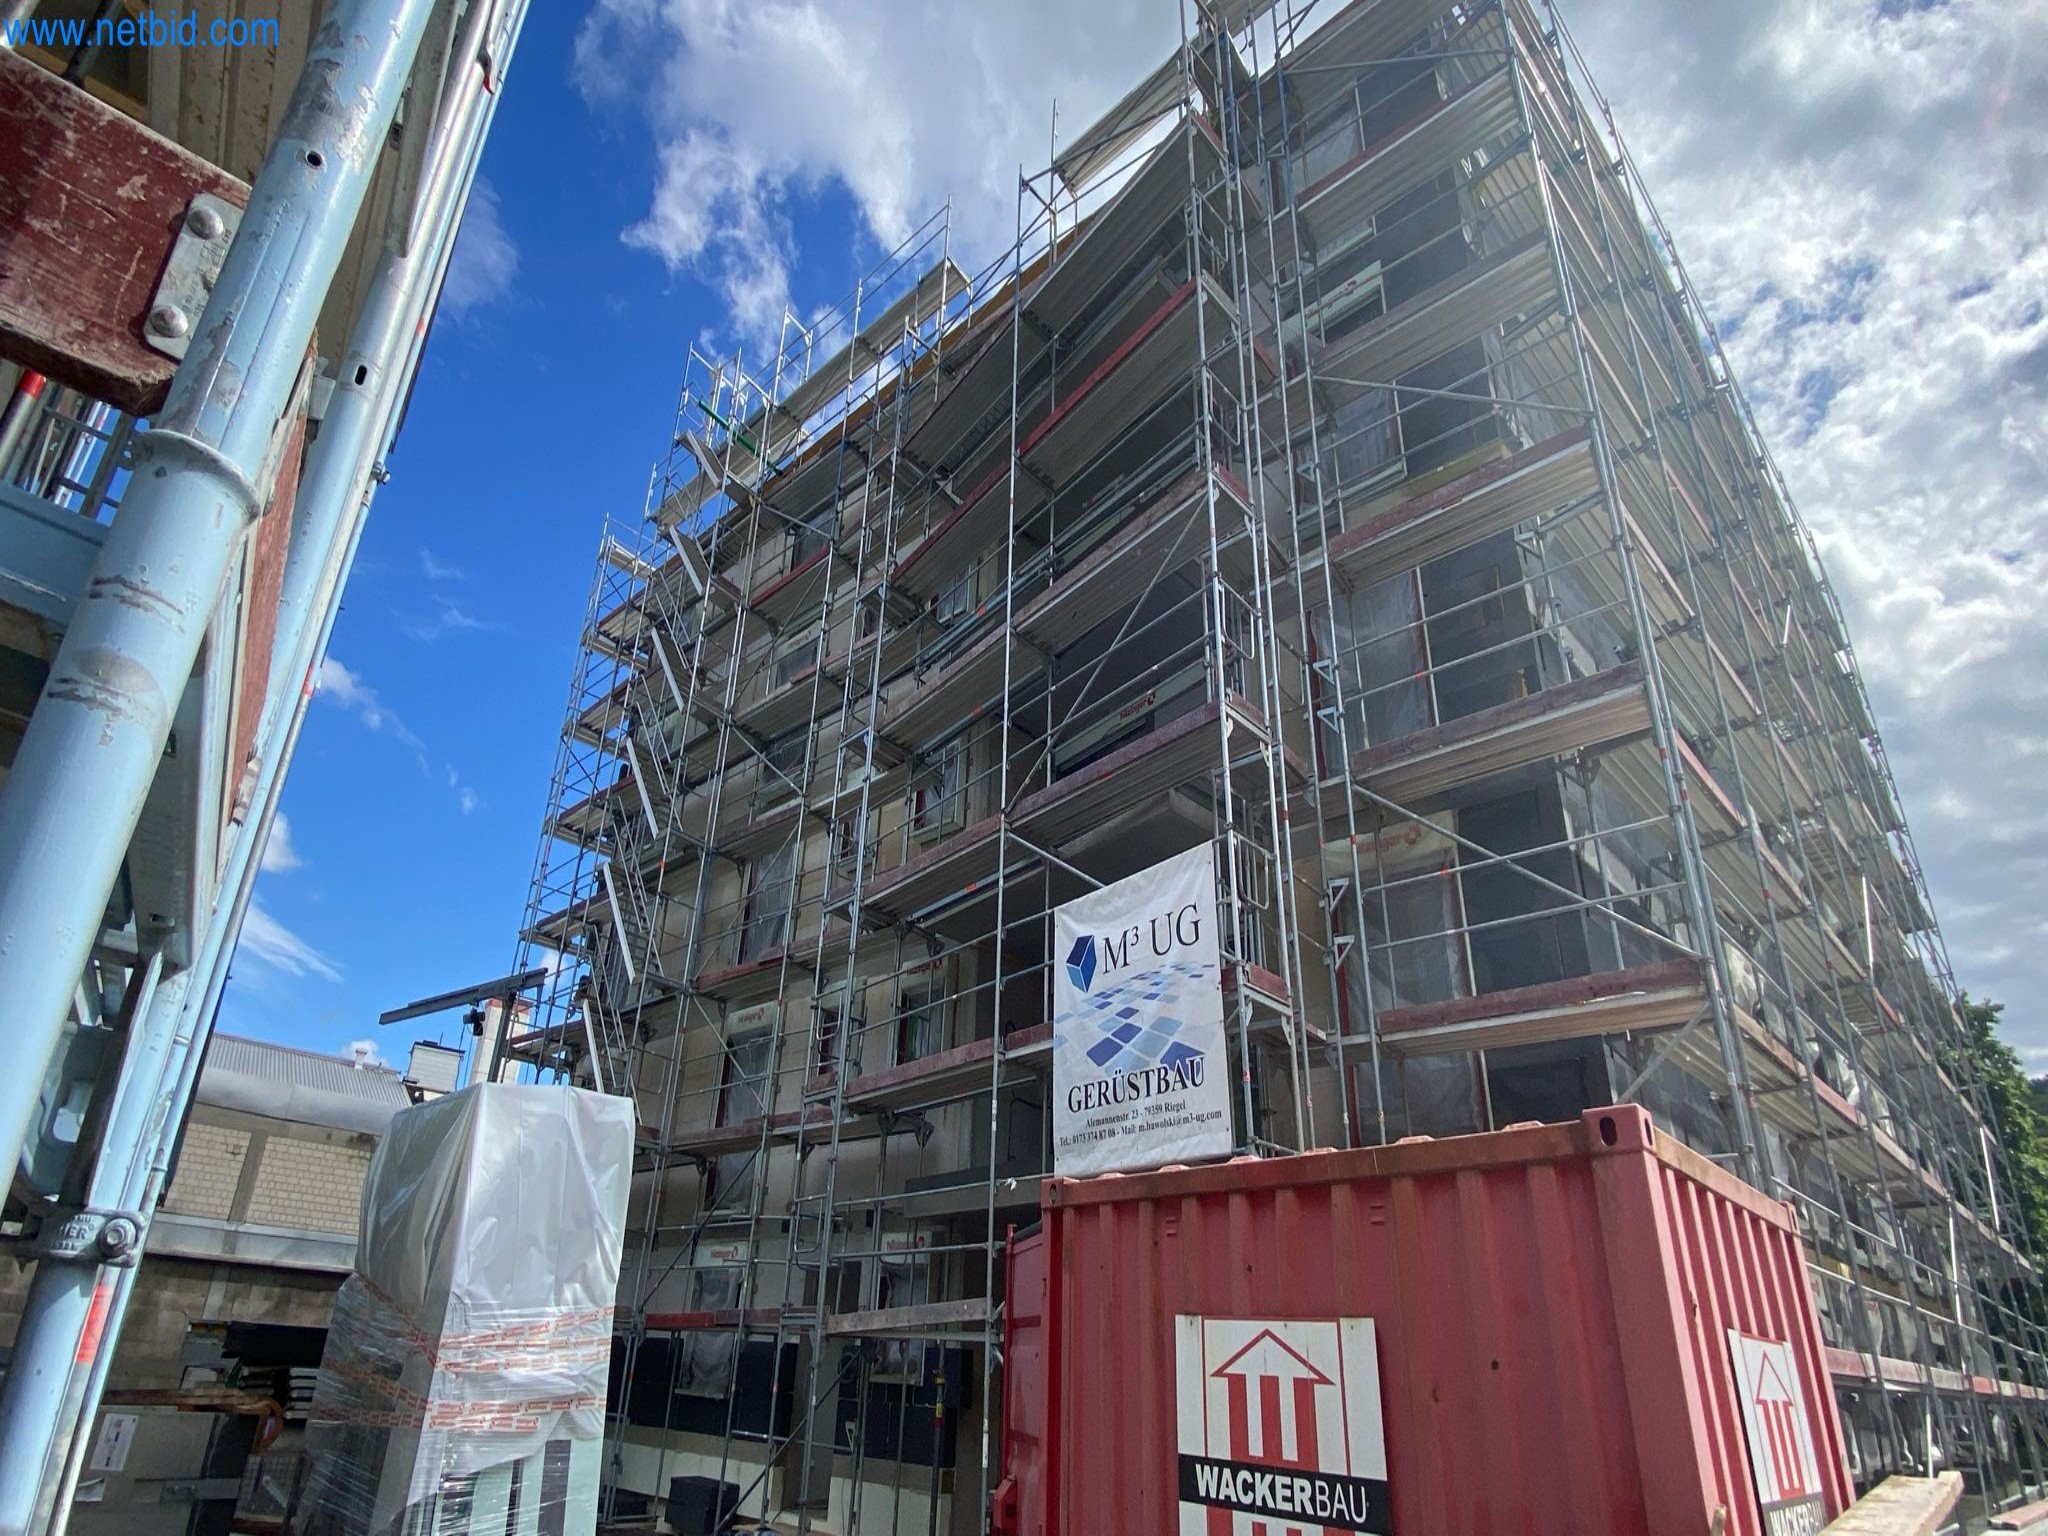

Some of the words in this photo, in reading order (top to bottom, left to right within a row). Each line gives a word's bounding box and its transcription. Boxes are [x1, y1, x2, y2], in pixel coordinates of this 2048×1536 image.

[1150, 902, 1201, 957] UG
[1068, 1056, 1206, 1114] GERÜSTBAU
[1131, 1109, 1139, 1121] 23
[1164, 1100, 1187, 1114] Riegel
[1195, 1463, 1367, 1524] WACKERBAU
